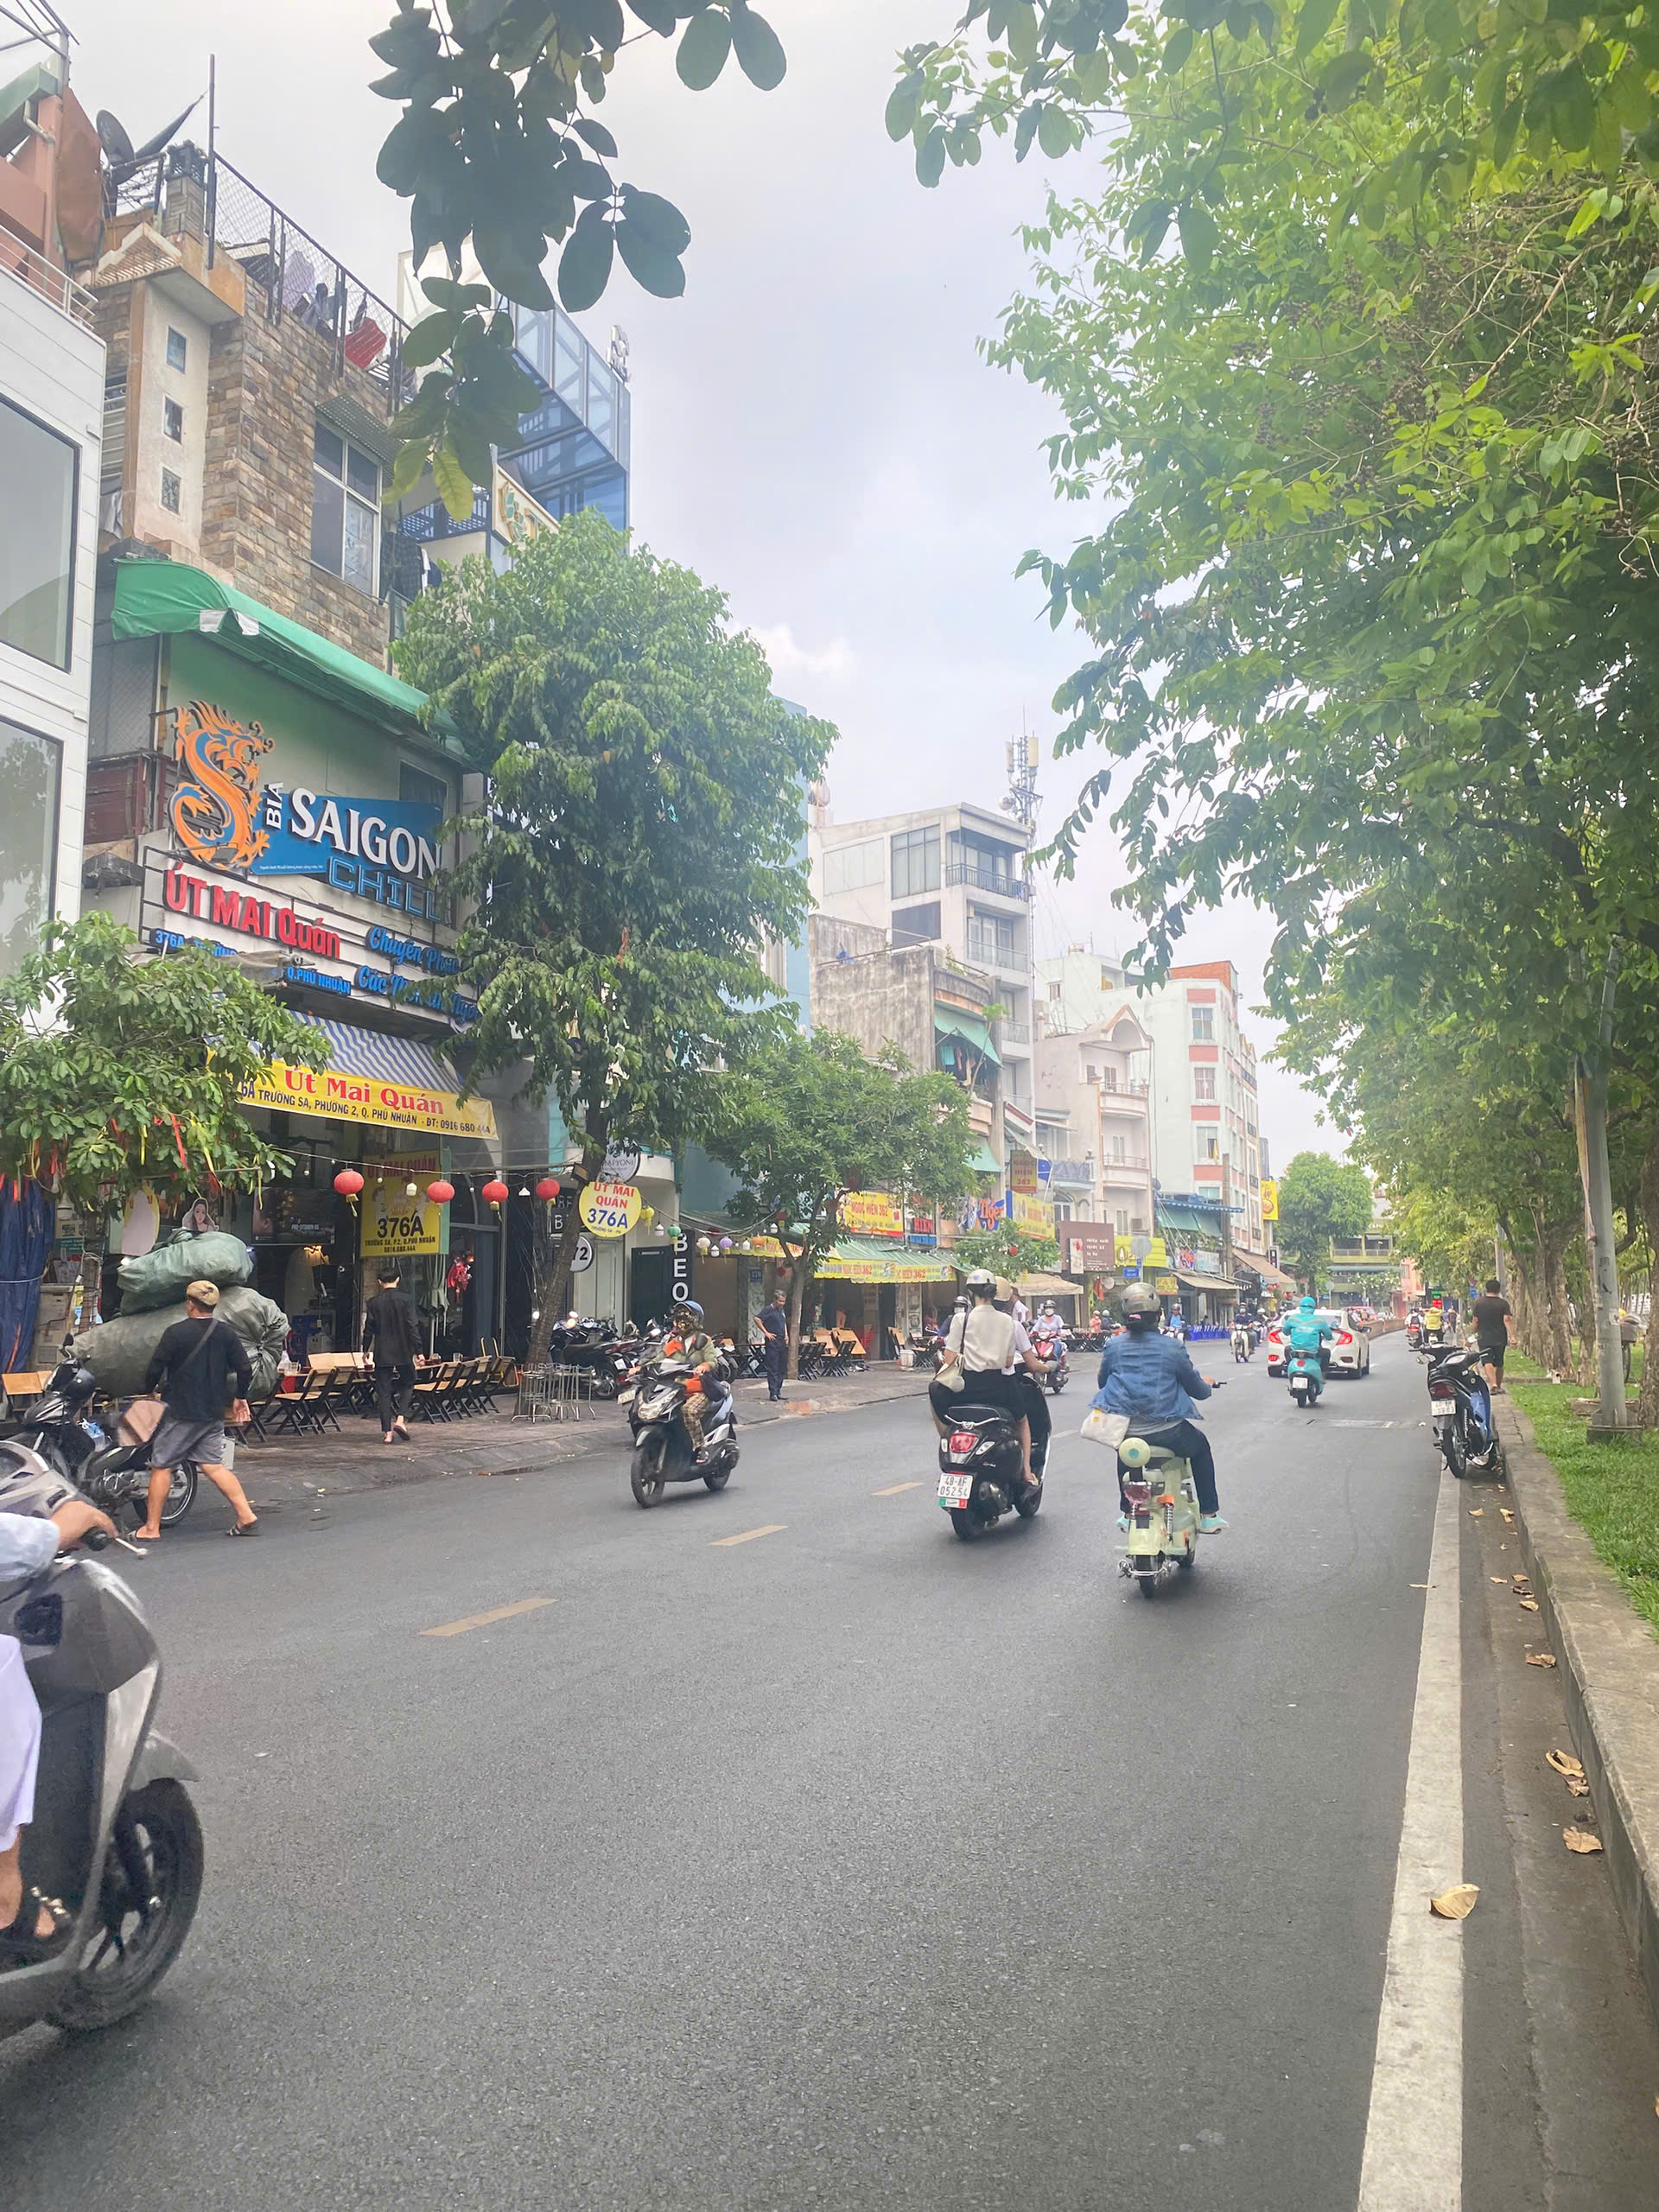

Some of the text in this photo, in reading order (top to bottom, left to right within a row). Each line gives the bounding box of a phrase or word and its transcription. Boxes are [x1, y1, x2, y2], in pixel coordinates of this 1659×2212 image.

[266, 781, 283, 830] BIA
[291, 787, 442, 880] SAIGON
[164, 860, 341, 959] ÚT MAI Quán
[328, 856, 443, 923] CHILL
[258, 1089, 296, 1107] TRƯỜNG
[297, 1096, 312, 1110] SA,
[315, 1099, 349, 1115] PHƯỜNG
[352, 1105, 359, 1118] 2,
[361, 1109, 370, 1119] Q.
[372, 1108, 388, 1122] PHÚ
[391, 1112, 417, 1126] NHUẬN
[440, 1119, 459, 1131] 0916
[460, 1121, 475, 1133] 680
[283, 1066, 444, 1115] Út Mai Quán
[595, 1194, 629, 1209] QUÁN
[613, 1184, 636, 1198] MAI
[587, 1208, 629, 1229] 376A
